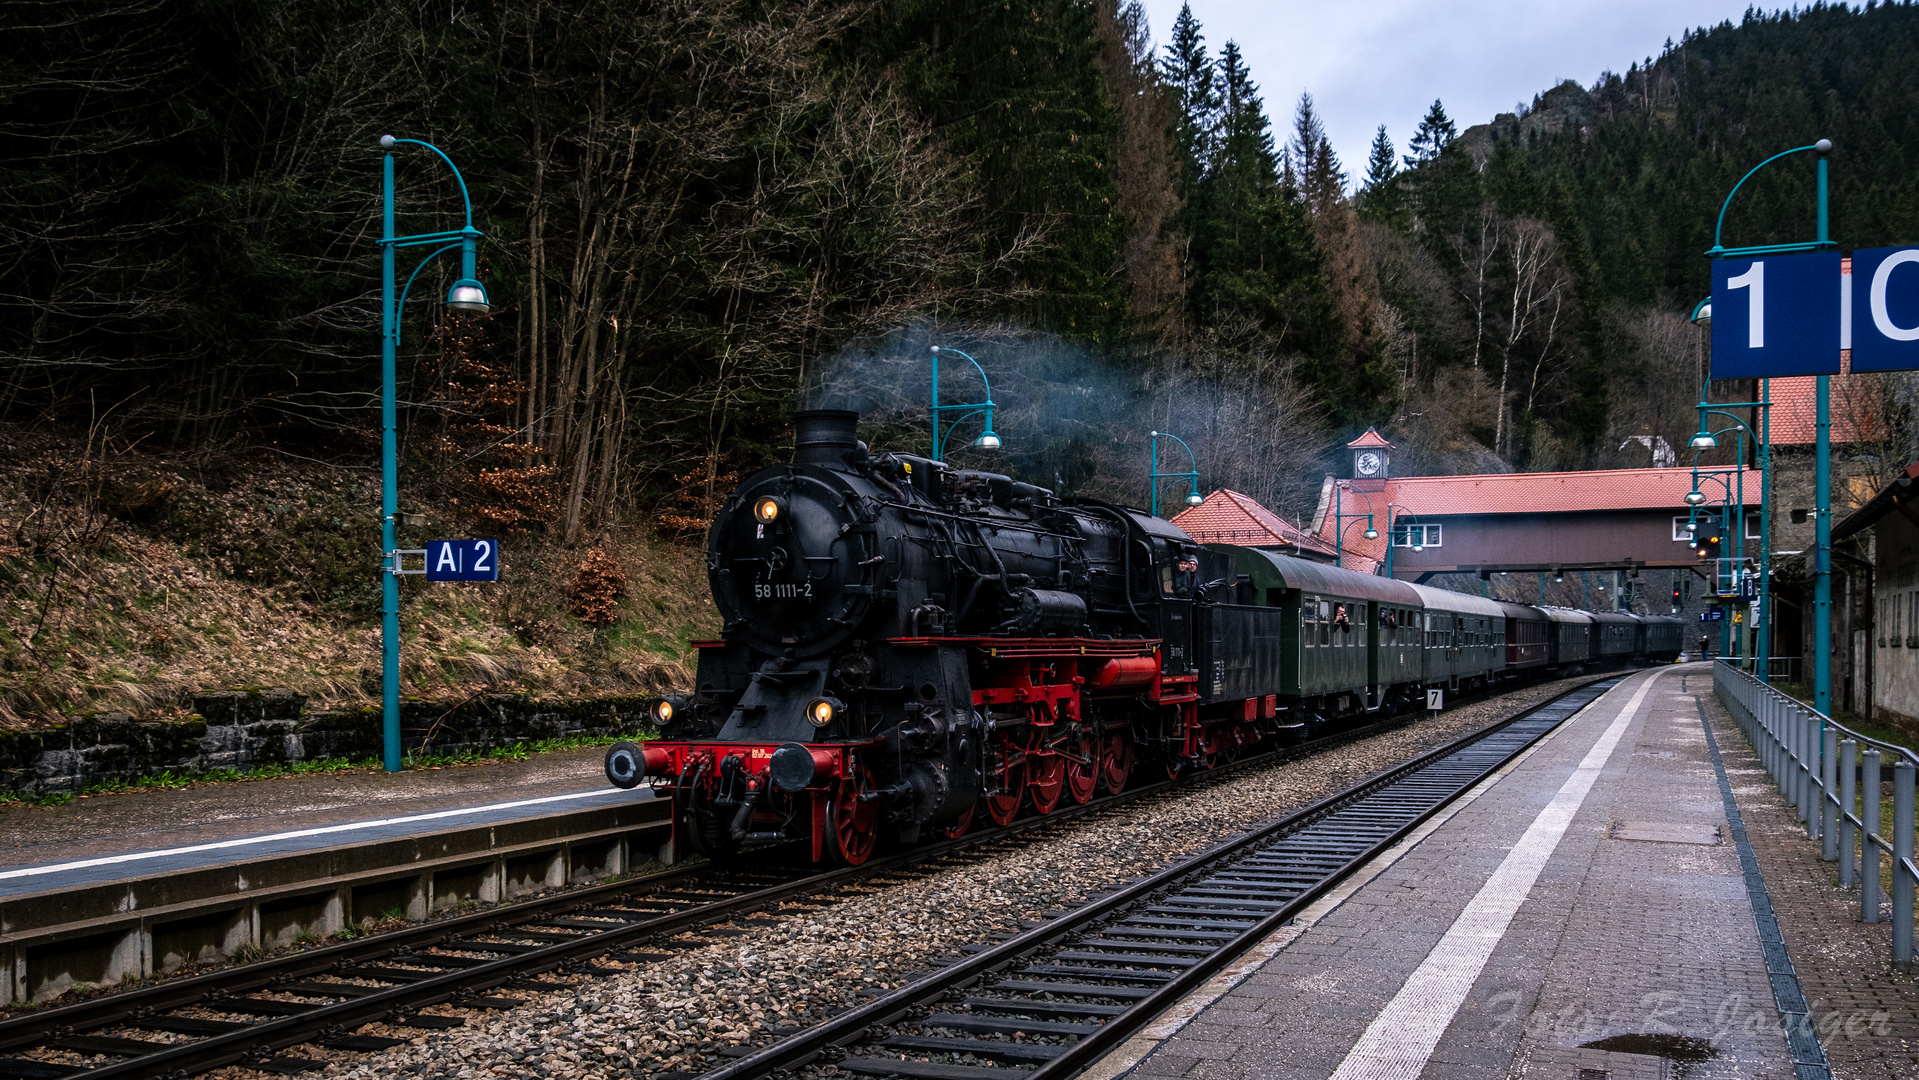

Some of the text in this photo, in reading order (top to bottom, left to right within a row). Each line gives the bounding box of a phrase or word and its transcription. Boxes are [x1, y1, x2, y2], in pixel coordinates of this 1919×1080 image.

[1727, 261, 1764, 348] 1
[436, 540, 491, 572] A 2
[755, 583, 812, 598] 58 1111-2
[1747, 579, 1753, 596] B
[1699, 613, 1705, 621] 1
[1431, 691, 1439, 706] 7
